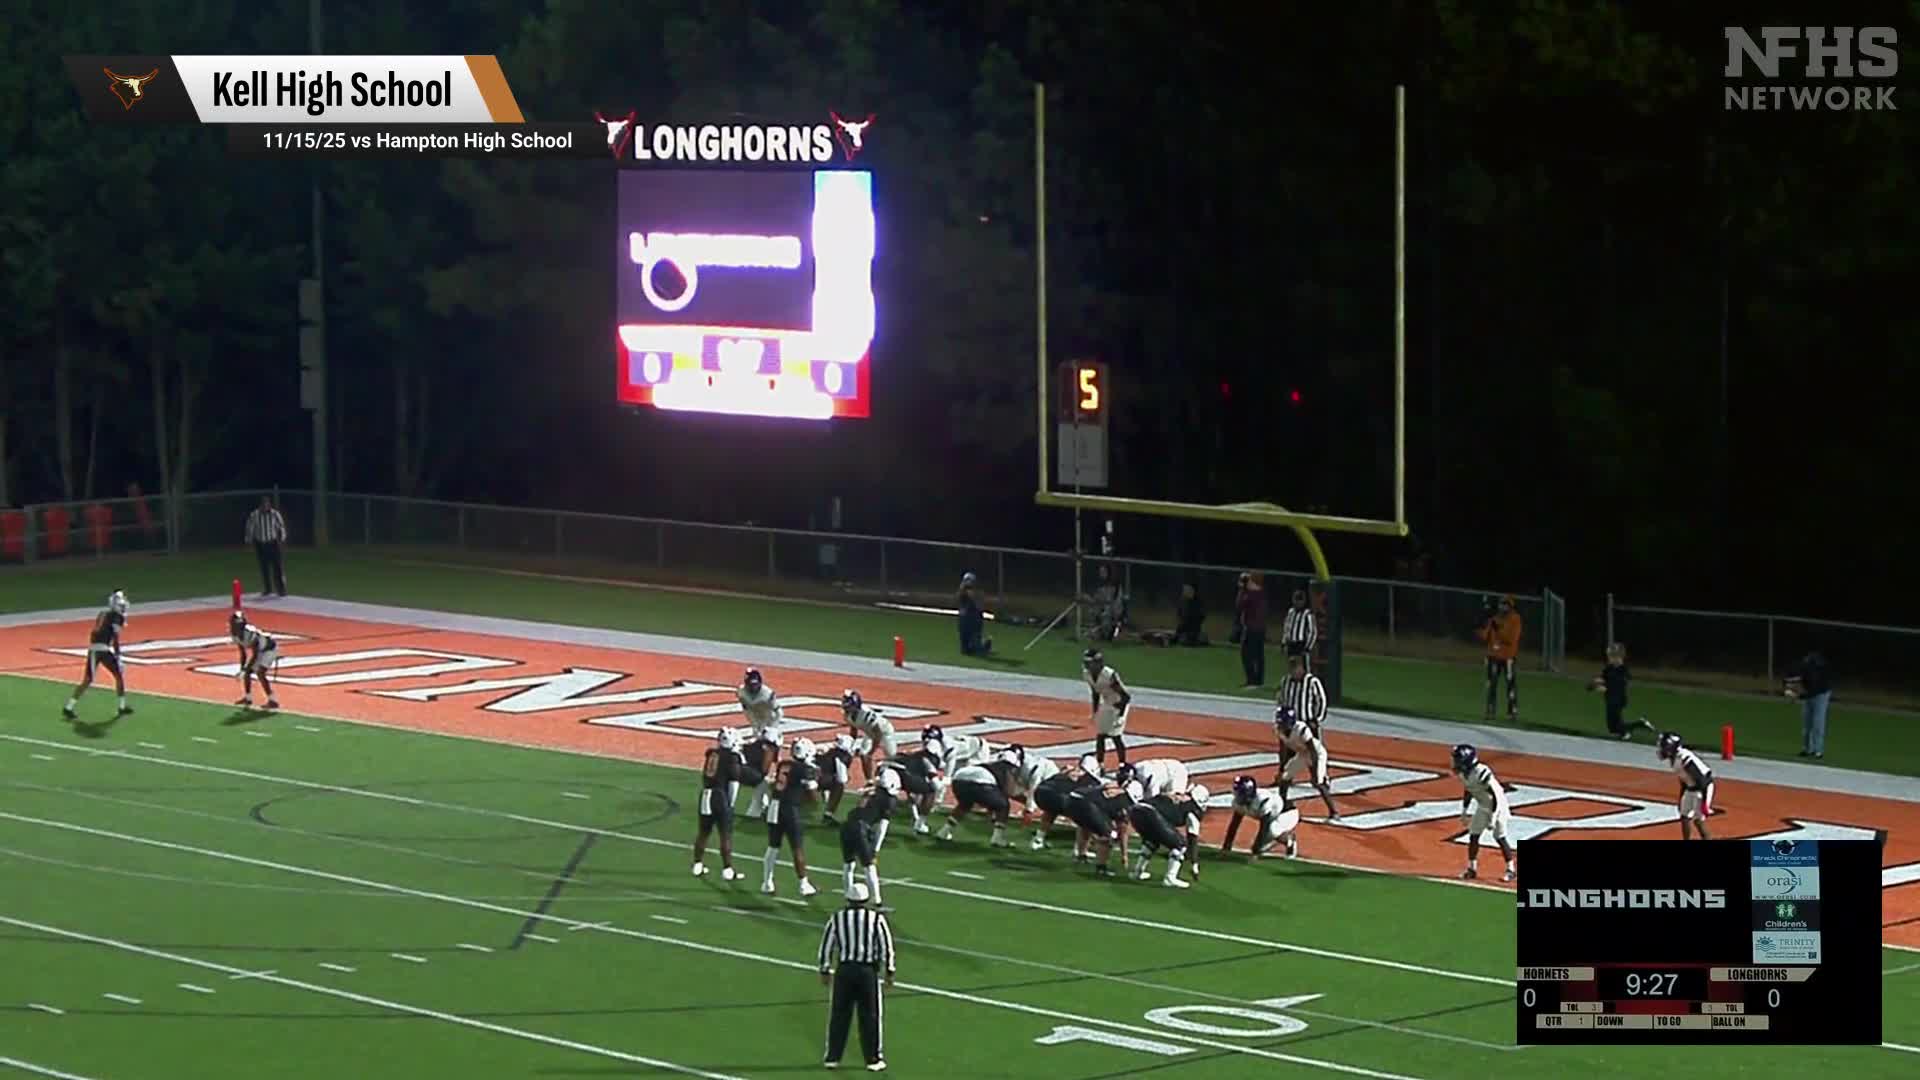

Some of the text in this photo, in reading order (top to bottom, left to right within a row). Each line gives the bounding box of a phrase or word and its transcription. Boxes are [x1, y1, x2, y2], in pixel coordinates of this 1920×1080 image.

[634, 125, 833, 162] LONGHORNS
[1079, 368, 1098, 410] 5
[1033, 1004, 1310, 1056] 10
